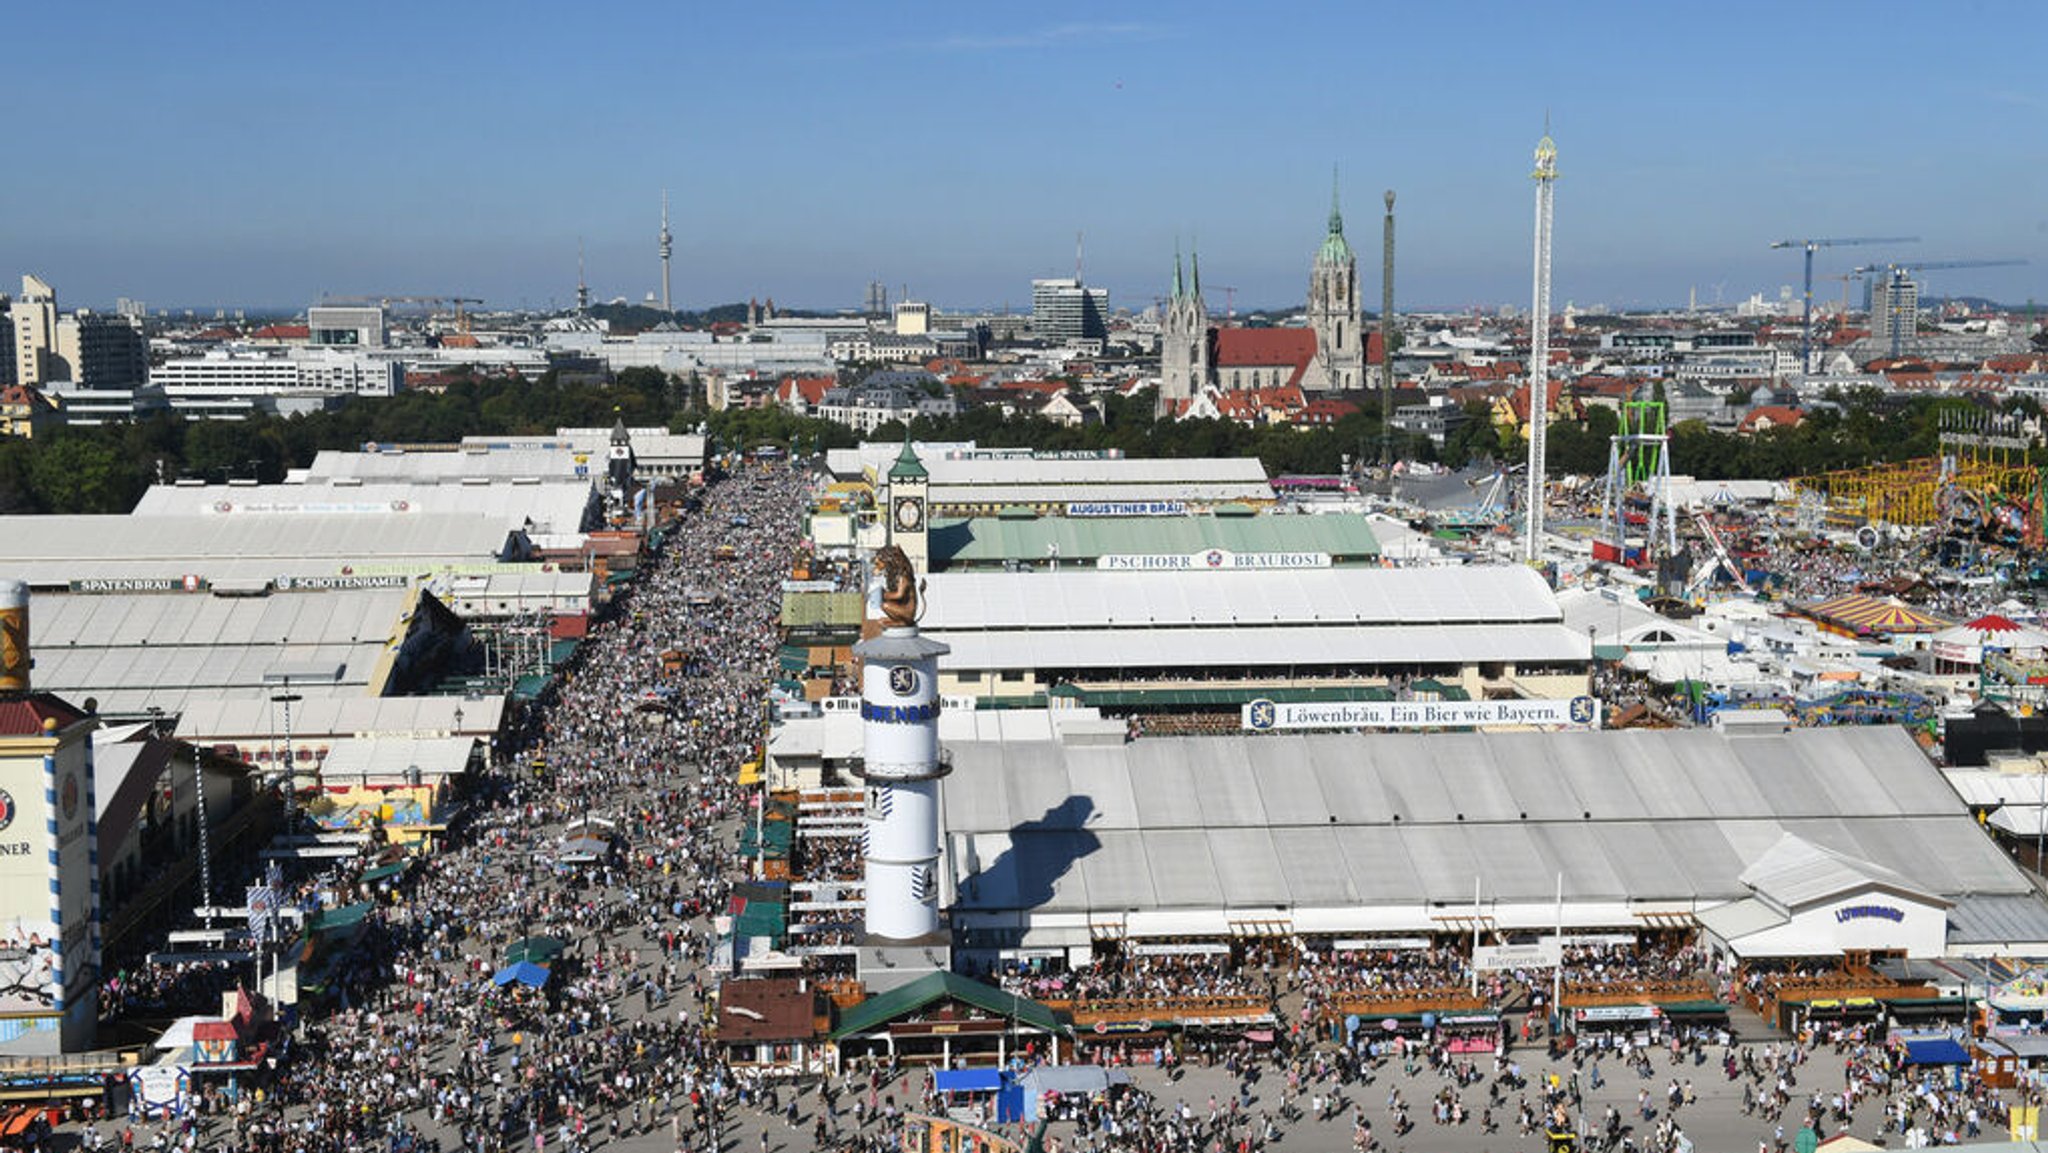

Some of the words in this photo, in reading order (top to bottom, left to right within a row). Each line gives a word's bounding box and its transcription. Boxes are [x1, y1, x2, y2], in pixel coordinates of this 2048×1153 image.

[1070, 503, 1148, 513] AUGUSTINER
[1150, 501, 1182, 513] BRÄU
[1109, 556, 1191, 567] PSCHORR
[1287, 706, 1385, 723] Löwenbräu.
[1391, 706, 1419, 722] Ein
[1425, 706, 1459, 721] Bier
[1464, 705, 1491, 720] wie
[1497, 704, 1560, 724] Bayern.
